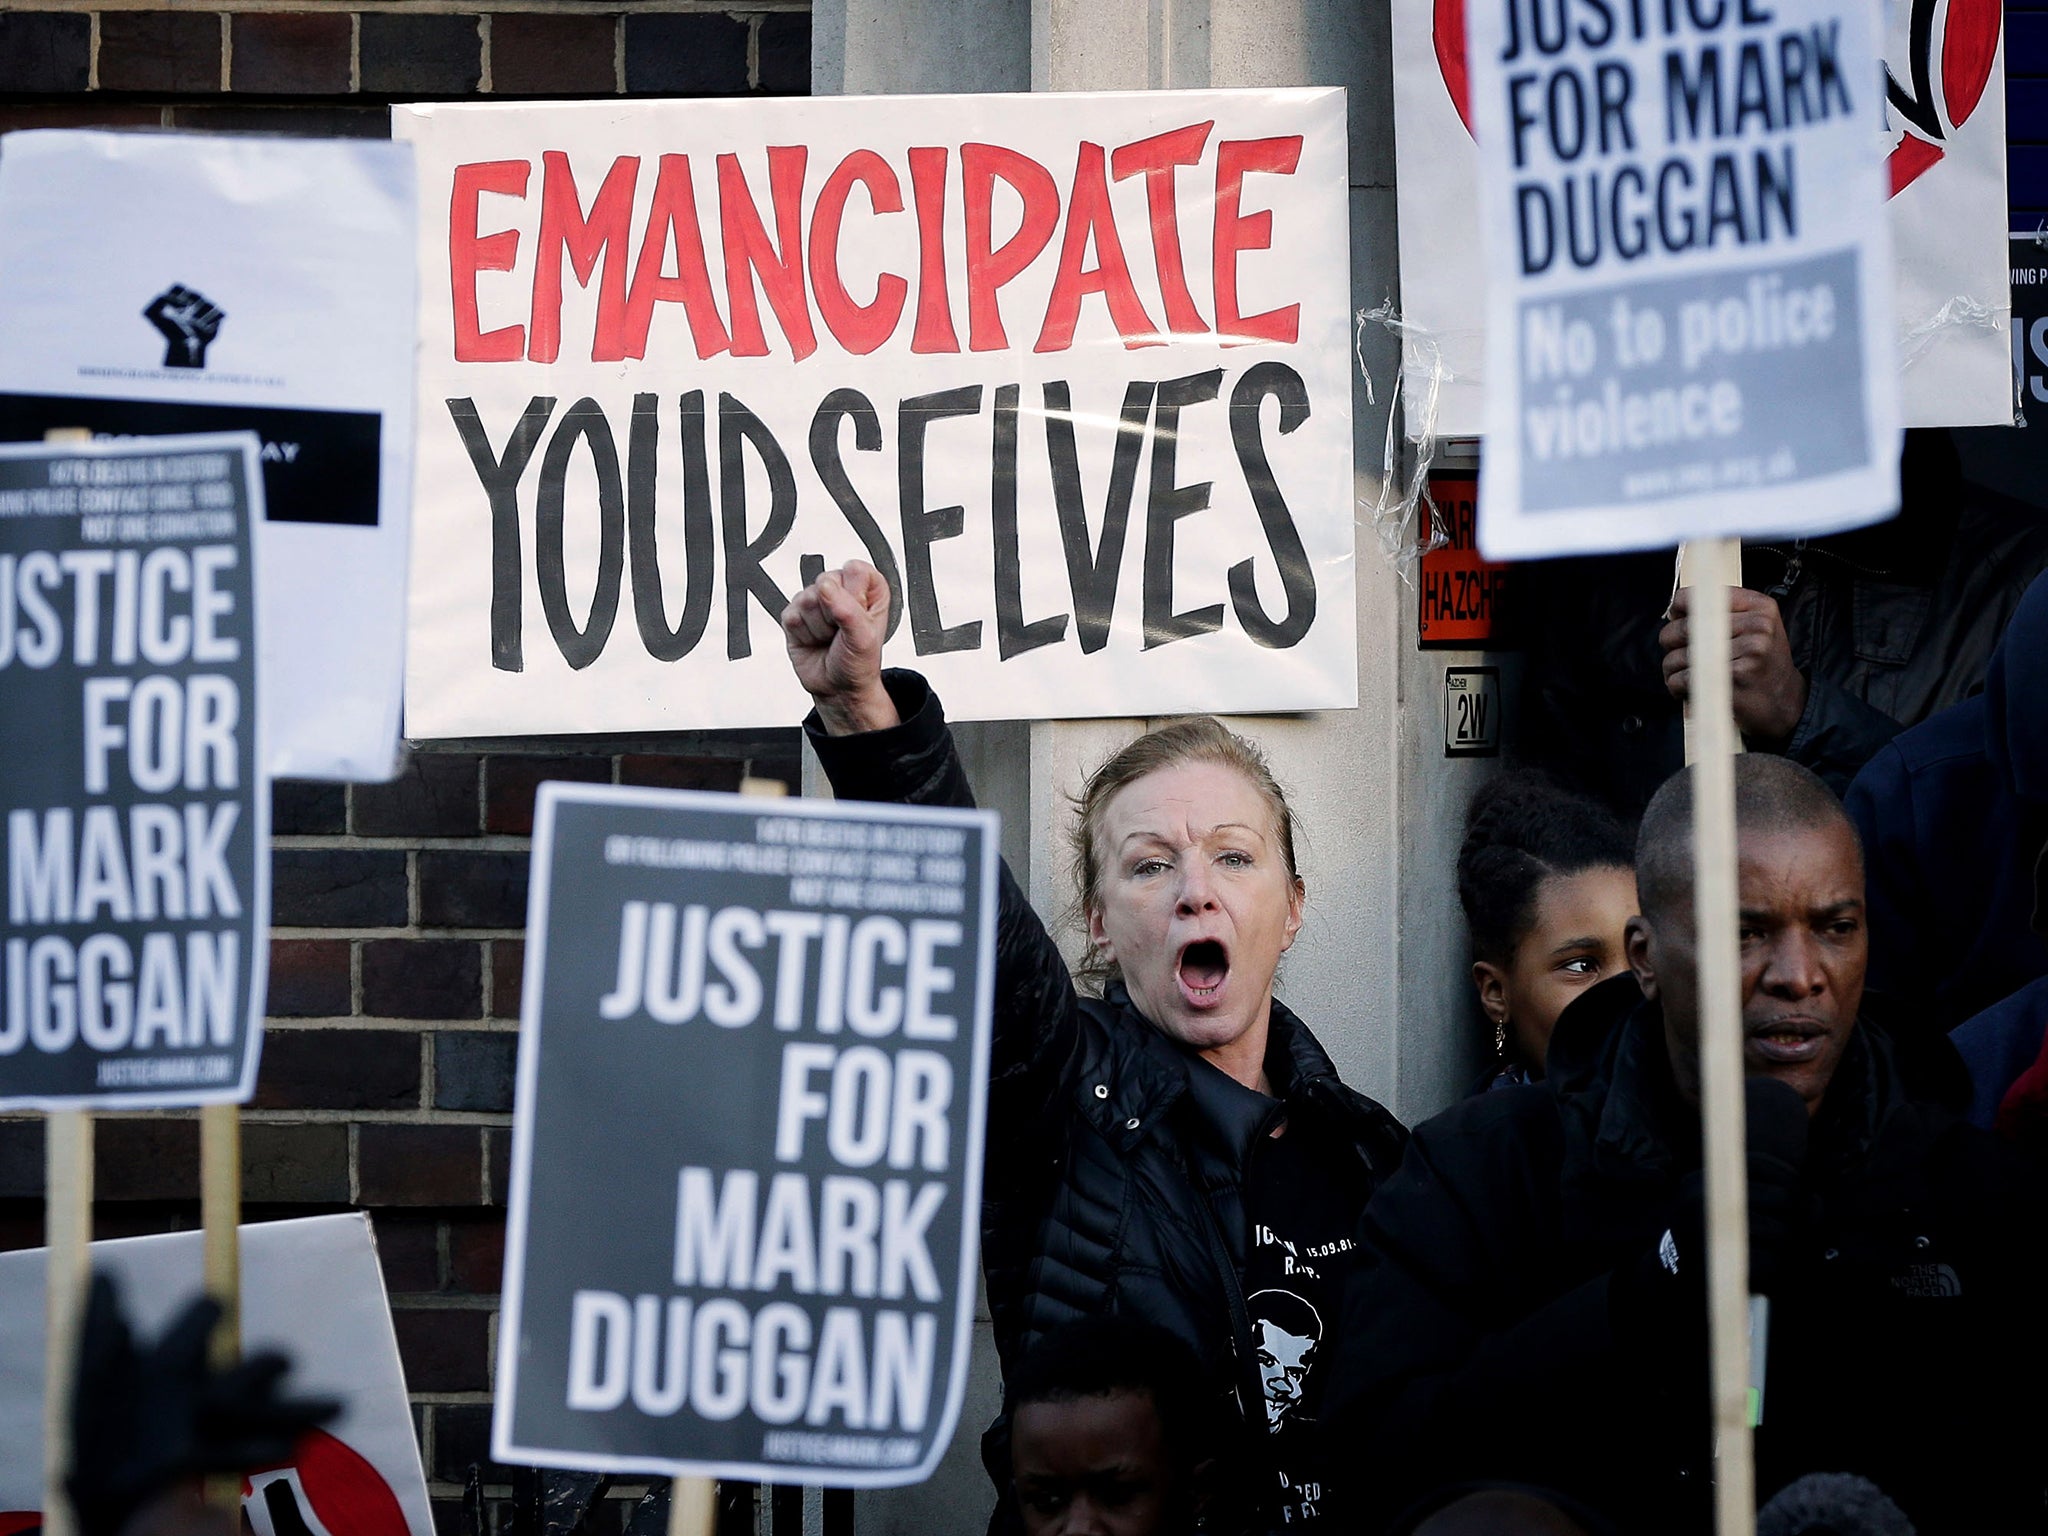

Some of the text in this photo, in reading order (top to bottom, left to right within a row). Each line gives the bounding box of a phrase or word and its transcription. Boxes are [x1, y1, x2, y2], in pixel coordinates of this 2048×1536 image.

[1501, 0, 1775, 62] JUST
[1507, 18, 1853, 169] FOR MARK
[449, 119, 1304, 364] EMANCIPATE
[1515, 144, 1799, 278] DUGGAN
[1524, 273, 1837, 383] No to police
[1526, 375, 1745, 462] violence
[445, 361, 1317, 673] YOURSELVES
[83, 673, 240, 795] FOR
[1457, 694, 1489, 739] 2W
[7, 801, 242, 926] MARK
[600, 900, 964, 1041] JUSTICE
[775, 1042, 954, 1171] FOR
[672, 1165, 949, 1303] MARK
[566, 1289, 938, 1433] DUGGAN
